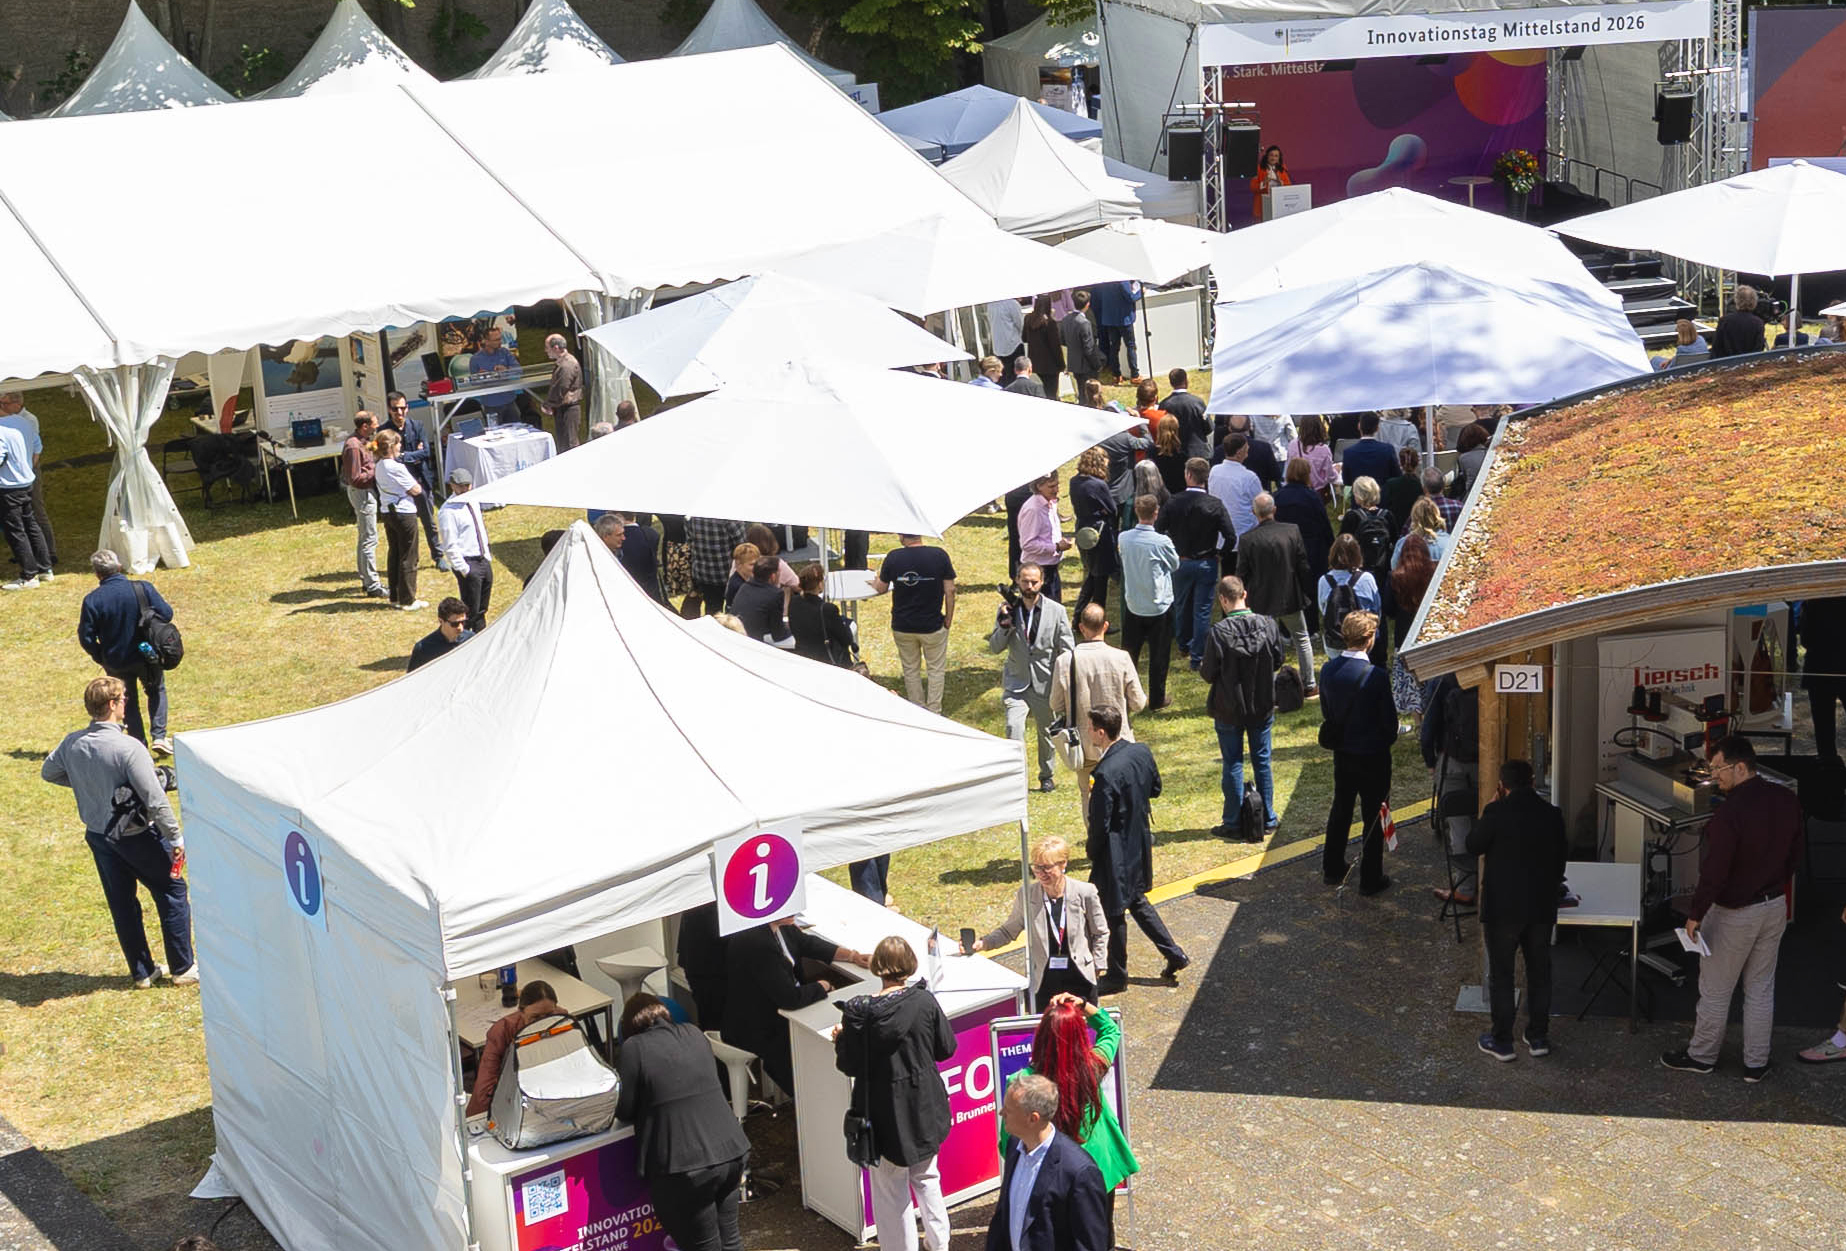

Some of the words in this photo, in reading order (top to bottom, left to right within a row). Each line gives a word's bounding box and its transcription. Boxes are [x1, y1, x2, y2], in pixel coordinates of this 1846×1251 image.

[1367, 26, 1498, 45] Innovationstag
[1503, 18, 1600, 38] Mittelstand
[1607, 15, 1645, 31] 2026
[1233, 65, 1268, 78] Stark.
[1271, 62, 1326, 76] Mittelst
[1499, 671, 1541, 690] D21
[1634, 663, 1719, 686] Liersch
[1000, 1044, 1032, 1057] THEM
[940, 1055, 995, 1100] FO
[577, 1204, 655, 1240] INNOVATIO
